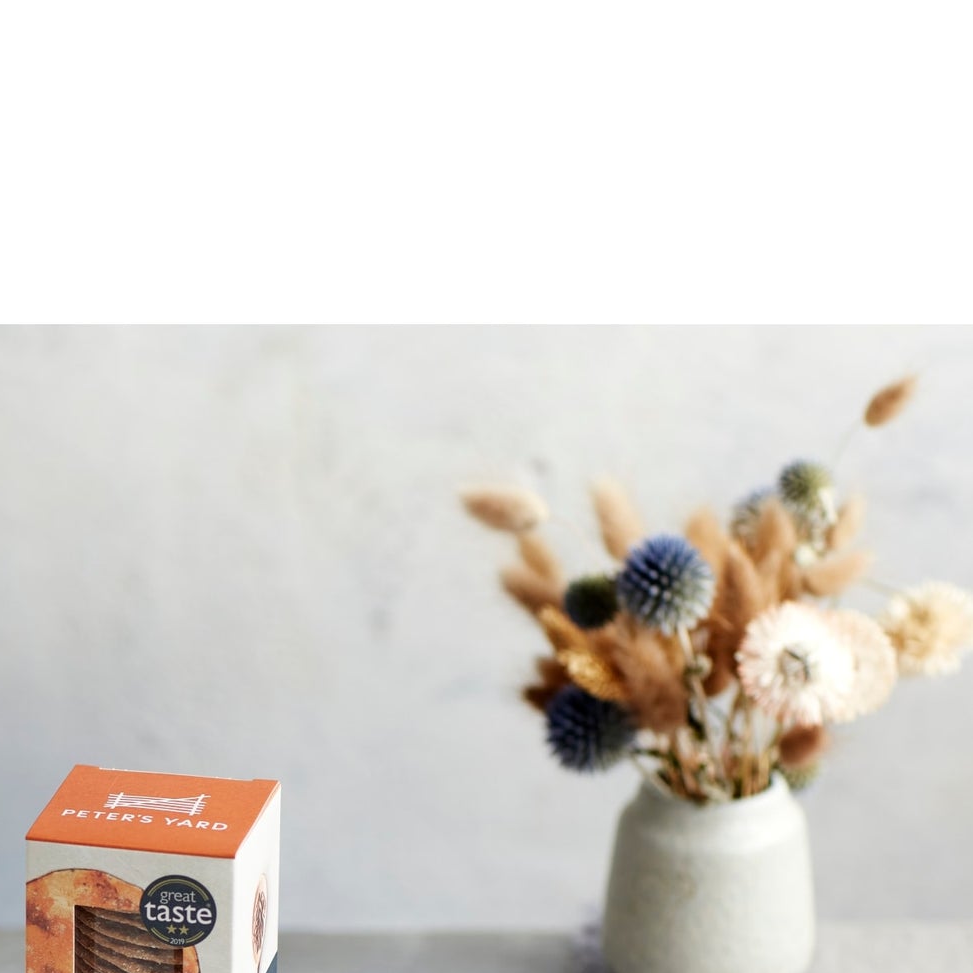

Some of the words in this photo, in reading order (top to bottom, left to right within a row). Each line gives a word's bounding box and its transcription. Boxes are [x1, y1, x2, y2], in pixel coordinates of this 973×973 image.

[61, 809, 153, 823] PETER'S
[164, 817, 228, 831] YARD
[159, 891, 197, 904] great
[144, 901, 213, 925] taste
[169, 937, 185, 945] 2019
